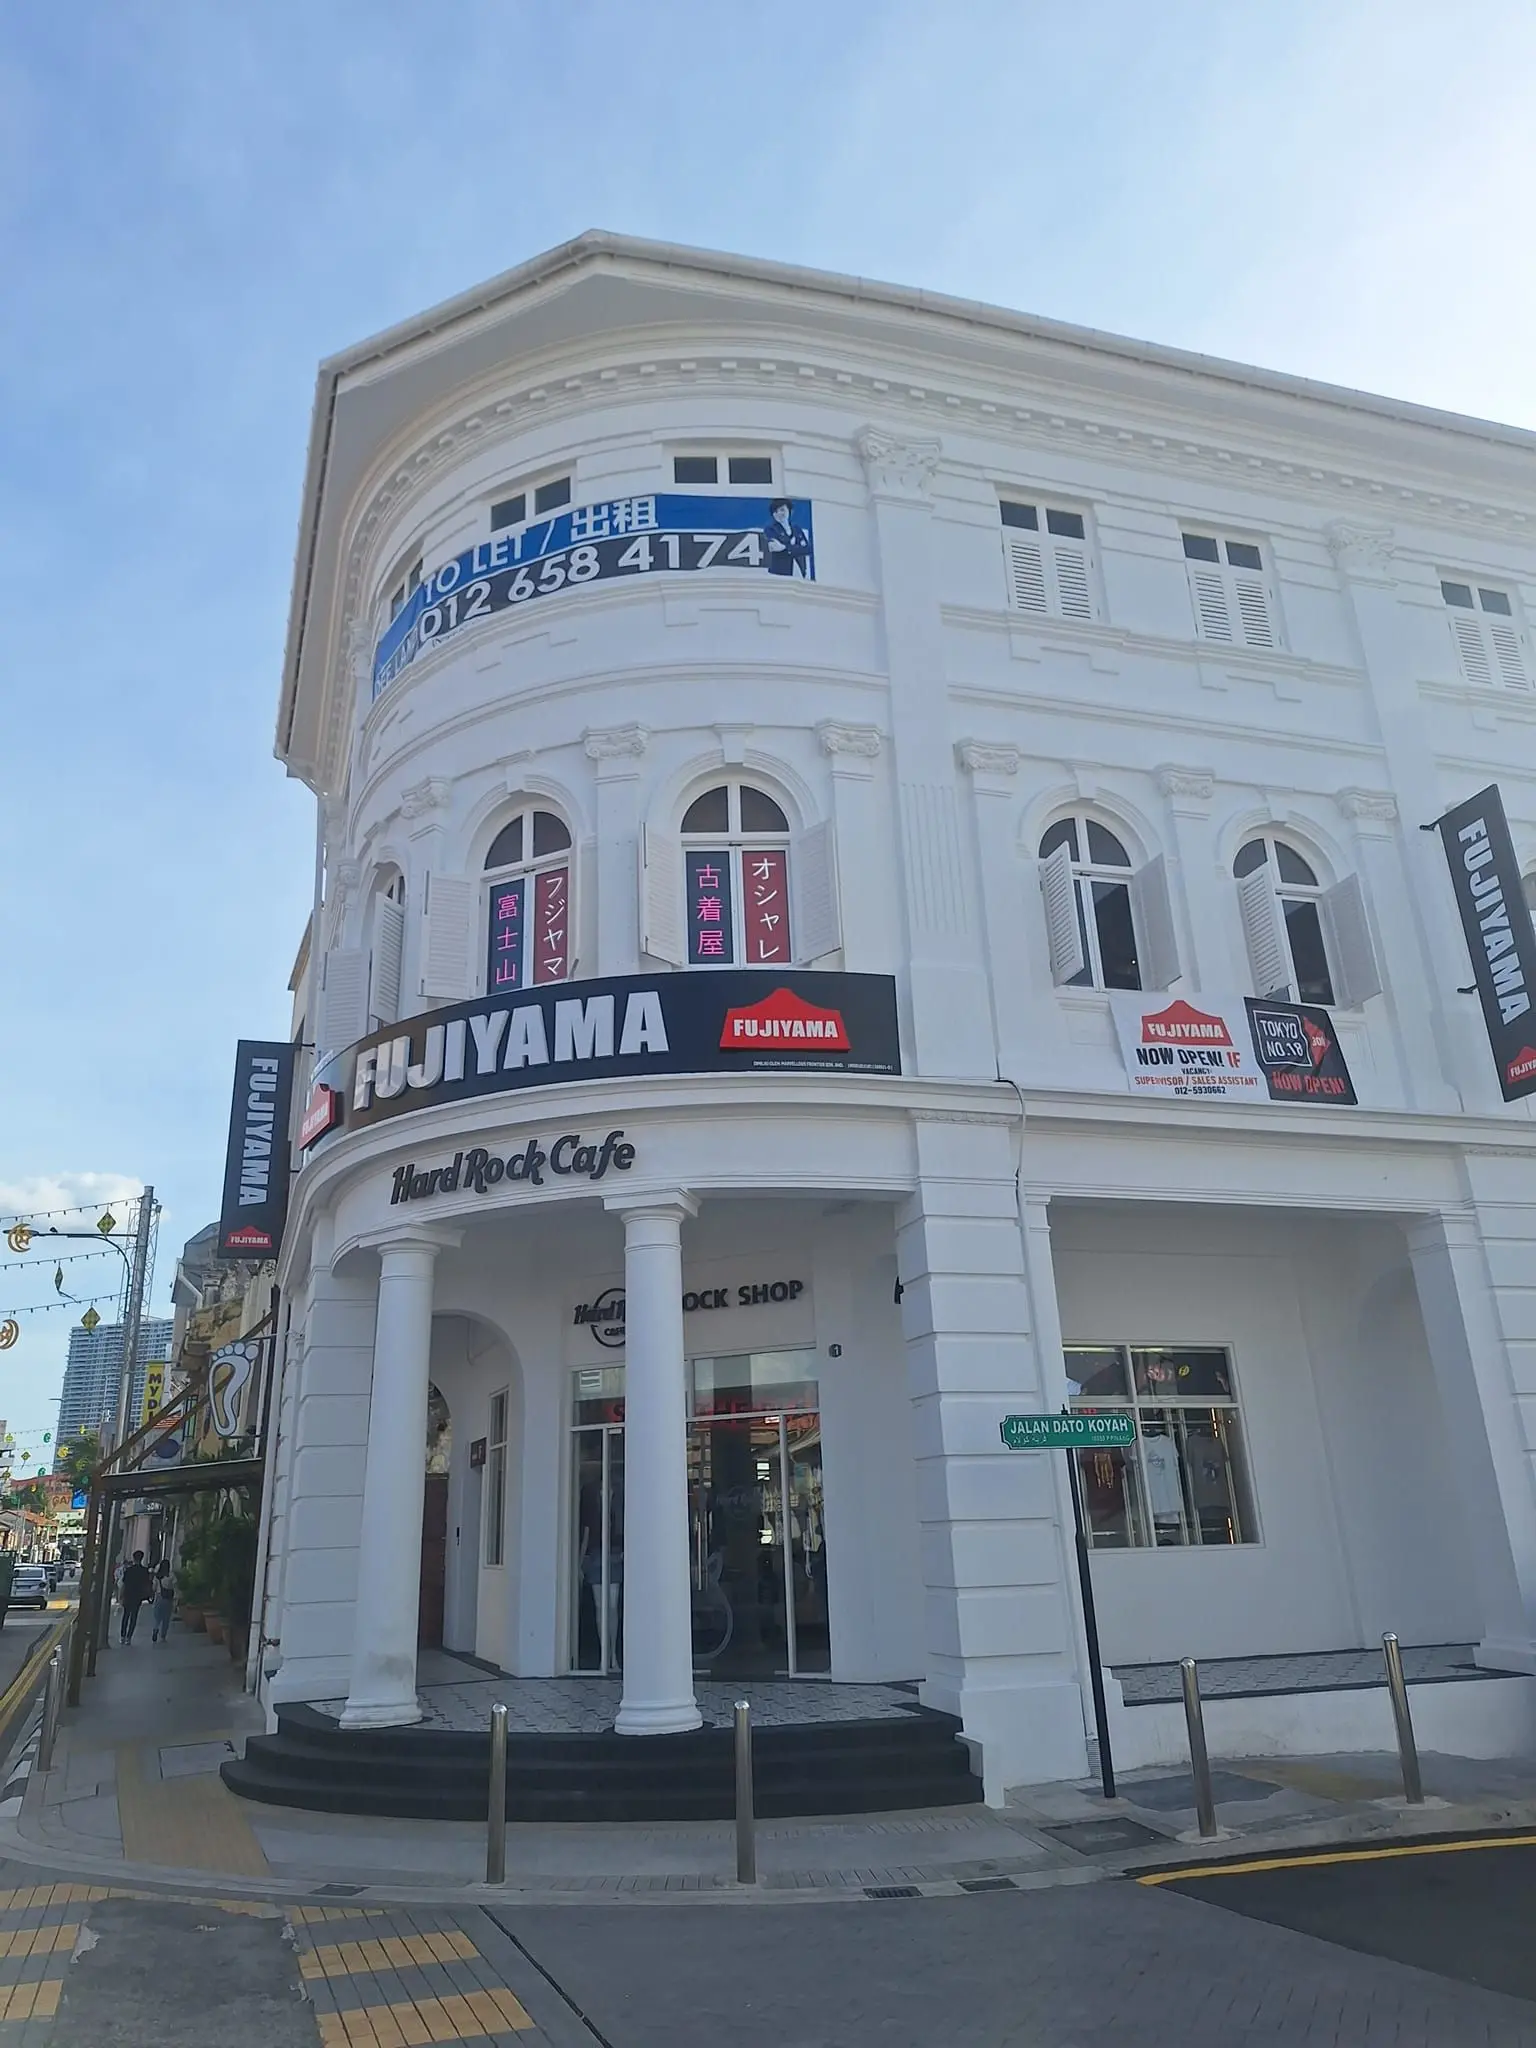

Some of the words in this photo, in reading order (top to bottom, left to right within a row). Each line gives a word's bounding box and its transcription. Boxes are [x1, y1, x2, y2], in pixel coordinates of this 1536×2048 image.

[423, 561, 460, 603] TO
[472, 528, 527, 574] LET
[570, 495, 659, 542] 出租
[419, 580, 492, 643] 012
[507, 545, 601, 602] 658
[617, 532, 764, 571] 4174
[695, 863, 725, 955] 古着屋
[751, 857, 780, 960] オシャレ
[1458, 817, 1531, 1026] FUJIYAMA
[495, 893, 519, 985] 富士山
[733, 1018, 839, 1039] FUJIYAMA
[1147, 1023, 1225, 1039] FUJIYAMA
[1259, 1019, 1299, 1040] TOKYO
[352, 990, 670, 1112] FUJIYAMA
[1136, 1047, 1174, 1066] NOW
[1177, 1048, 1225, 1068] OPEN!
[1265, 1040, 1304, 1058] NO.18
[1134, 1075, 1184, 1087] SUPERVISOR
[1191, 1075, 1217, 1086] SALES
[1218, 1075, 1258, 1087] ASSISTANT
[1303, 1073, 1347, 1096] OPEN!
[238, 1057, 279, 1207] FUJIYAMA
[389, 1152, 464, 1206] Hard
[462, 1139, 547, 1194] Rock
[550, 1130, 636, 1180] Cafe
[230, 1235, 269, 1245] FUJIYAMA
[682, 1287, 729, 1312] OCK
[738, 1279, 804, 1307] SHOP
[573, 1299, 616, 1325] Hard
[1010, 1420, 1050, 1434] JALAN
[1053, 1419, 1085, 1433] DATO
[1088, 1418, 1129, 1432] KOYAH
